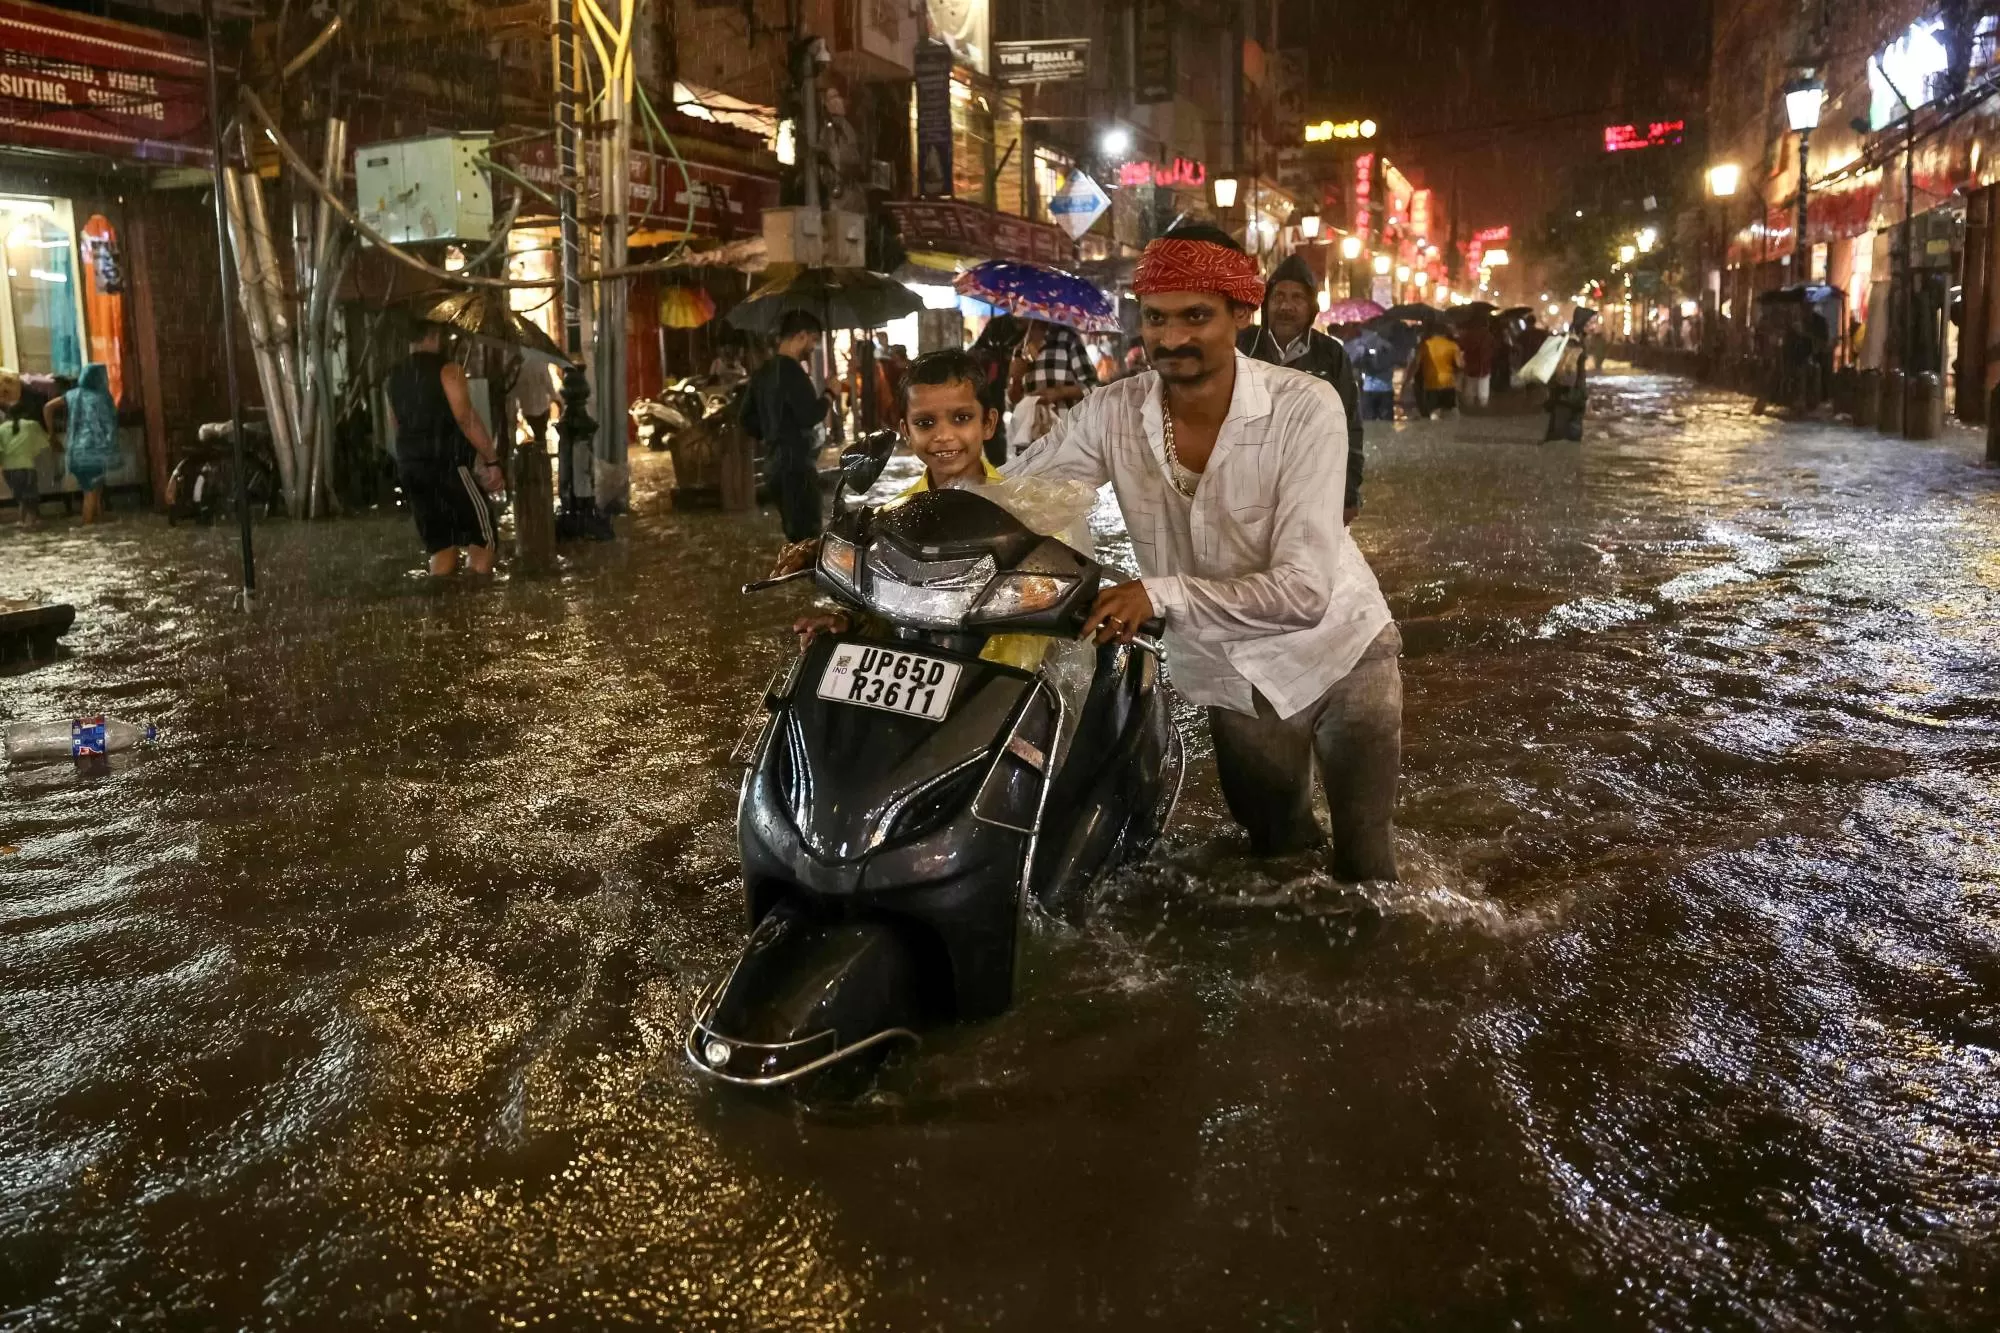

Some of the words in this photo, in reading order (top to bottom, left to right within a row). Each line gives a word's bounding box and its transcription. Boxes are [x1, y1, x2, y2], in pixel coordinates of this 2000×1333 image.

[1000, 53, 1025, 65] THE
[1026, 50, 1075, 63] FEMALE
[832, 666, 847, 675] IND
[859, 647, 945, 686] UP65D
[848, 675, 936, 714] R3611
